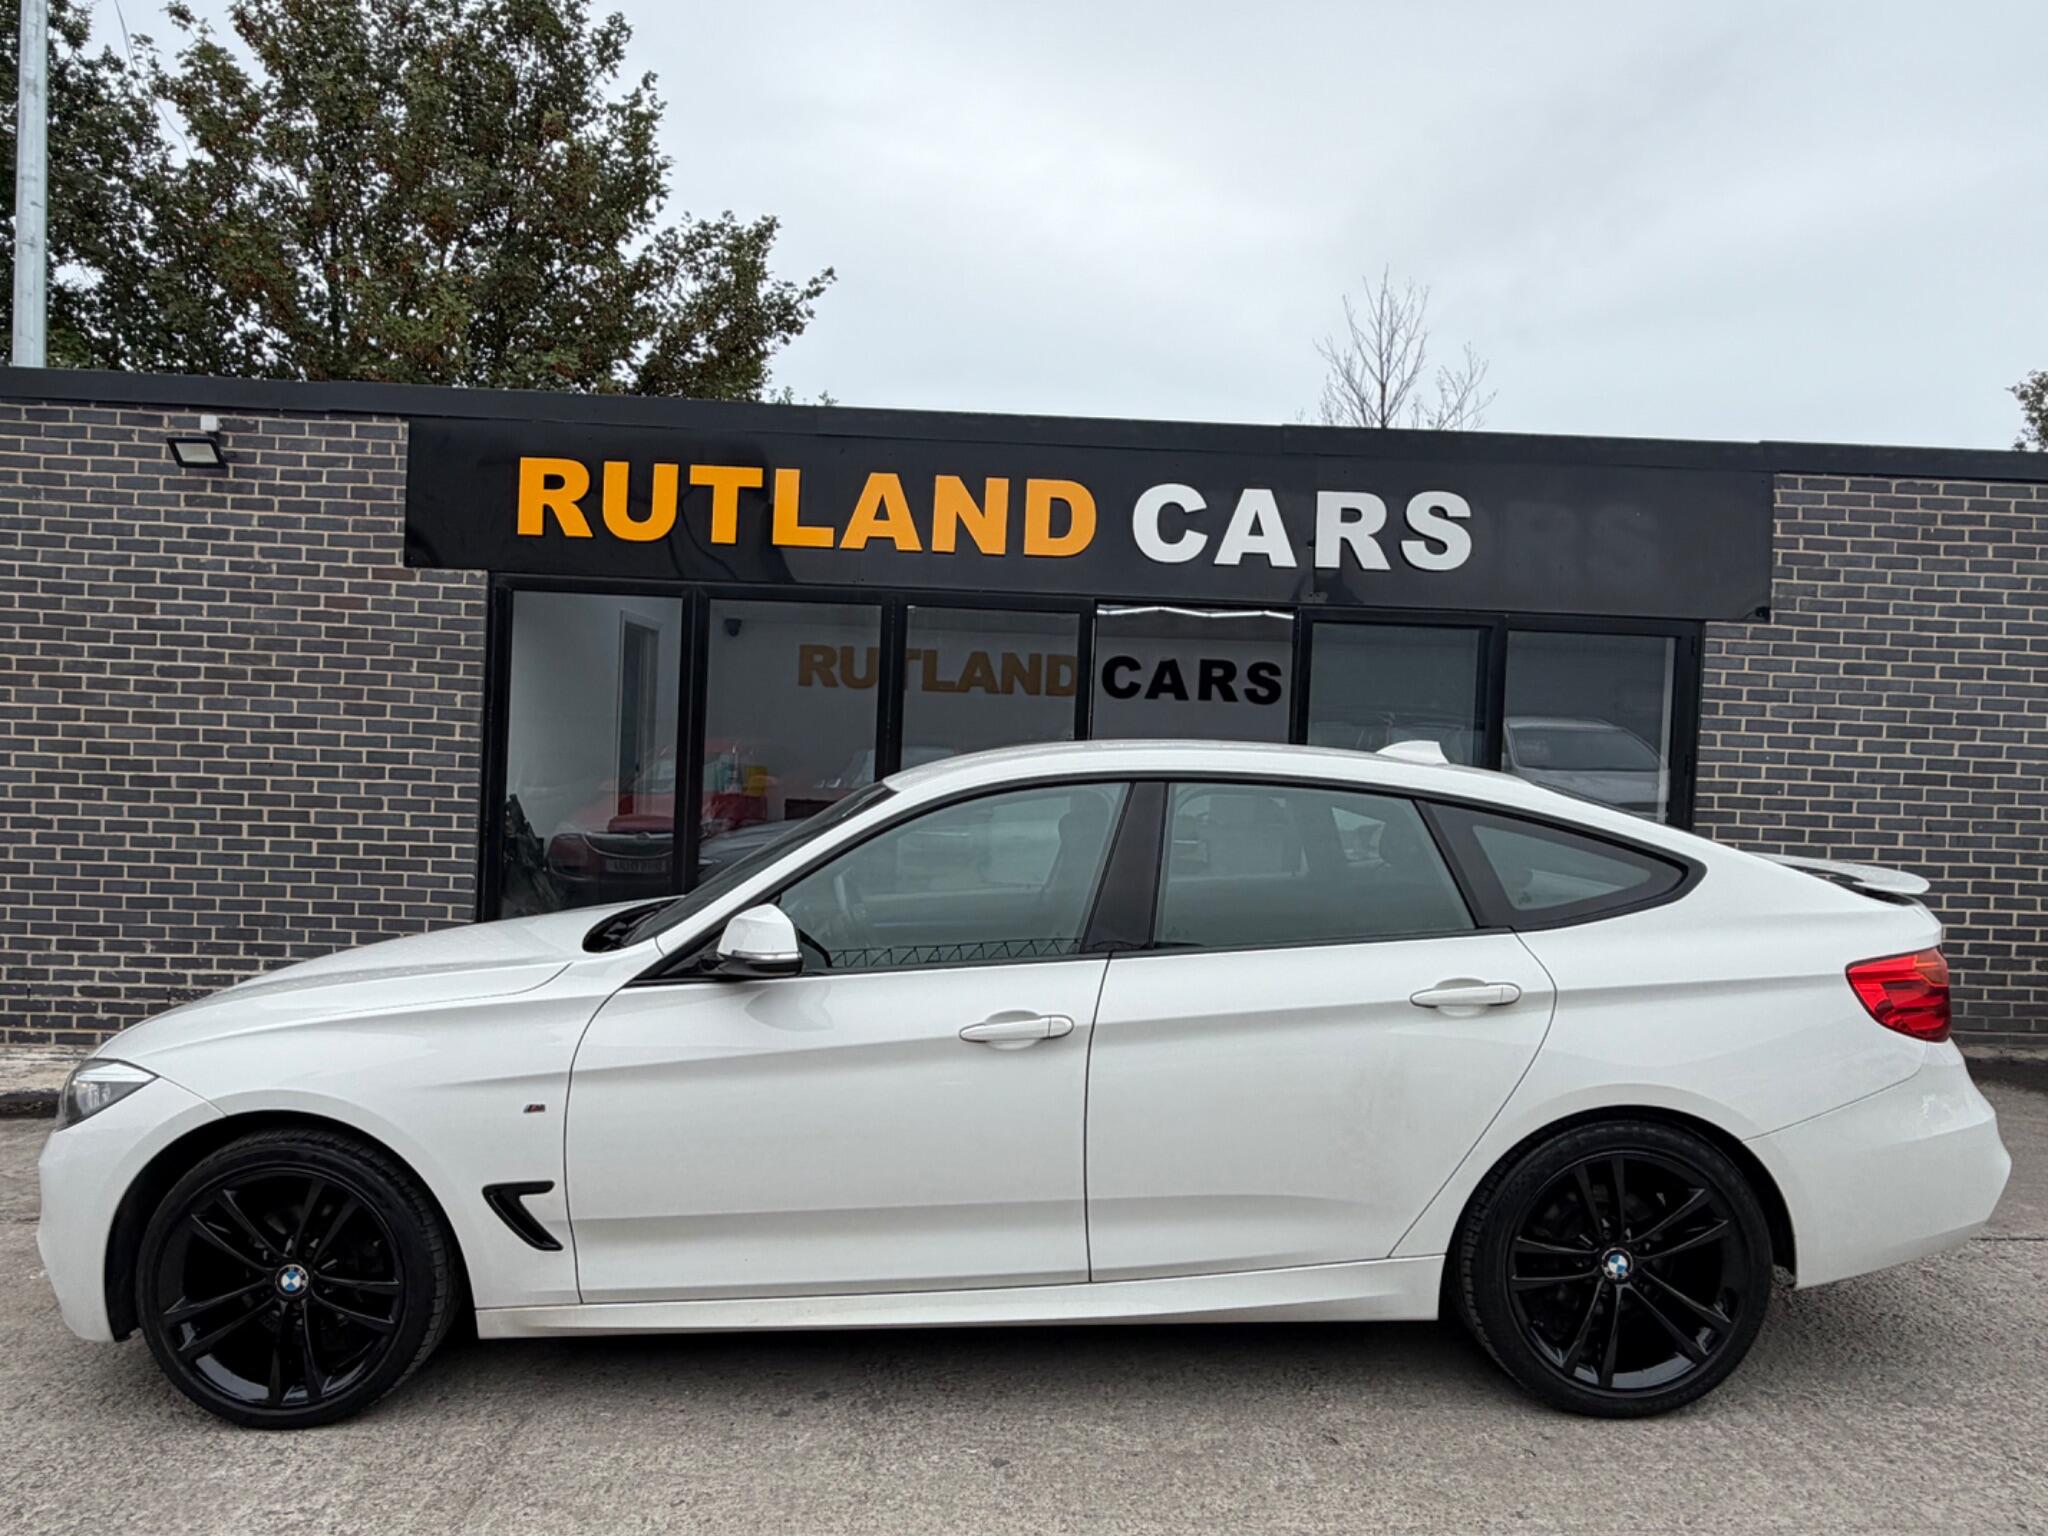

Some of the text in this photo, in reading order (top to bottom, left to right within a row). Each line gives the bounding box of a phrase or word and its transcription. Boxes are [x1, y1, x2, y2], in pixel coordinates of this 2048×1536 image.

[517, 457, 1472, 571] RUTLAND CARS
[1102, 656, 1282, 705] CARS
